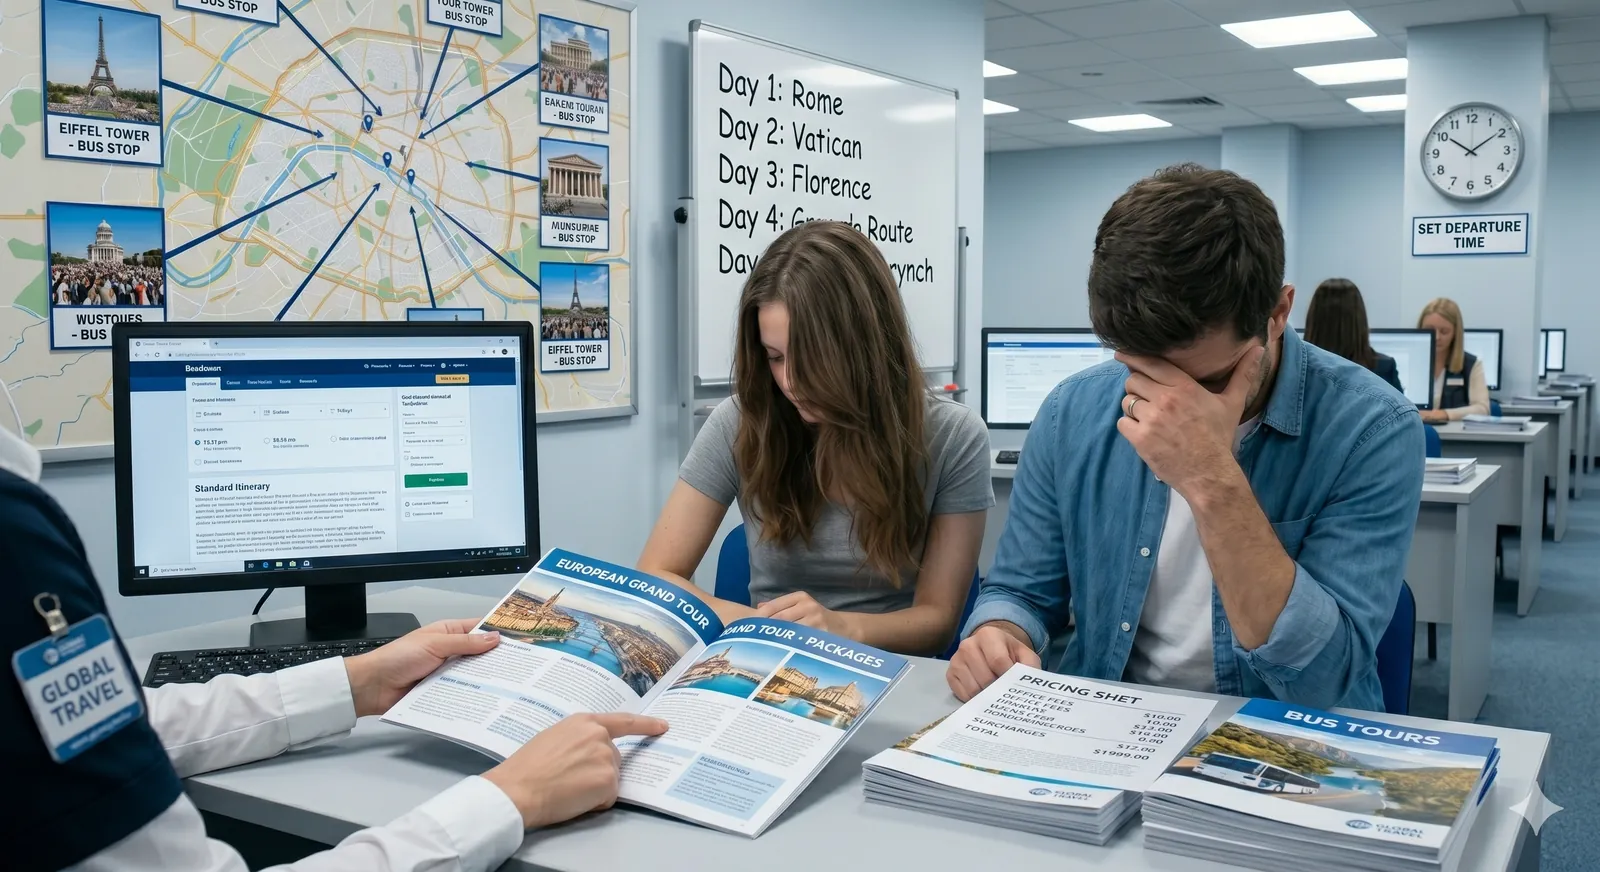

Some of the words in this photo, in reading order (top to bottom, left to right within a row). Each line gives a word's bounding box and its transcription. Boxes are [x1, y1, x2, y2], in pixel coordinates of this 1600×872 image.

[228, 0, 258, 14] STOP
[463, 1, 494, 16] TOWER
[445, 10, 463, 22] BUS
[464, 14, 488, 26] STOP
[719, 62, 759, 107] Day
[768, 73, 783, 102] 1:
[793, 79, 844, 116] Rome
[575, 102, 604, 115] TOURAN
[558, 111, 574, 122] BUS
[575, 114, 596, 125] STOP
[1450, 120, 1459, 130] 11
[1466, 113, 1478, 124] 12
[1488, 117, 1492, 127] 1
[59, 122, 102, 137] EIFFEL
[105, 127, 150, 142] TOWER
[719, 107, 759, 151] Day
[767, 117, 785, 145] 2:
[793, 121, 862, 160] Vatican
[1437, 132, 1449, 142] 10
[1497, 128, 1506, 138] 2
[78, 140, 104, 153] BUS
[107, 142, 141, 156] STOP
[1432, 148, 1440, 159] 9
[1503, 145, 1511, 155] 3
[1437, 165, 1445, 175] 8
[1497, 162, 1505, 172] 4
[719, 152, 759, 195] Day
[766, 160, 785, 188] 3:
[793, 163, 872, 200] Florence
[1450, 176, 1458, 186] 7
[1484, 175, 1492, 185] 5
[1466, 180, 1474, 190] 6
[719, 198, 759, 239] Day
[766, 204, 785, 232] 4:
[868, 214, 914, 244] Route
[1418, 222, 1442, 235] SET
[1445, 220, 1522, 234] DEPARTURE
[558, 233, 574, 243] BUS
[575, 234, 596, 244] STOP
[1453, 236, 1485, 249] TIME
[81, 329, 107, 340] BUS
[548, 345, 574, 355] EIFFEL
[575, 344, 602, 353] TOWER
[559, 356, 575, 366] BUS
[576, 355, 597, 365] STOP
[195, 483, 234, 493] Standard
[235, 482, 271, 493] Itinerary
[555, 558, 629, 585] EUROPEAN
[628, 579, 676, 603] GRAND
[676, 599, 711, 630] TOUR
[758, 624, 797, 640] TOUR
[804, 636, 884, 669] PACKAGES
[41, 656, 115, 704] GLOBAL
[1019, 674, 1091, 697] PRICING
[1093, 690, 1142, 705] SHET
[50, 679, 124, 726] TRAVEL
[1007, 687, 1047, 701] OFFICE
[1047, 697, 1075, 706] FEES
[1143, 712, 1181, 722] $10.00
[1043, 703, 1072, 713] FEES
[1147, 719, 1177, 728] 10.00
[971, 717, 1047, 738] SURCHARGES
[1283, 709, 1339, 729] BUS
[1345, 721, 1441, 746] TOURS
[964, 724, 1000, 737] TOTAL
[1093, 747, 1150, 761] $1999.00
